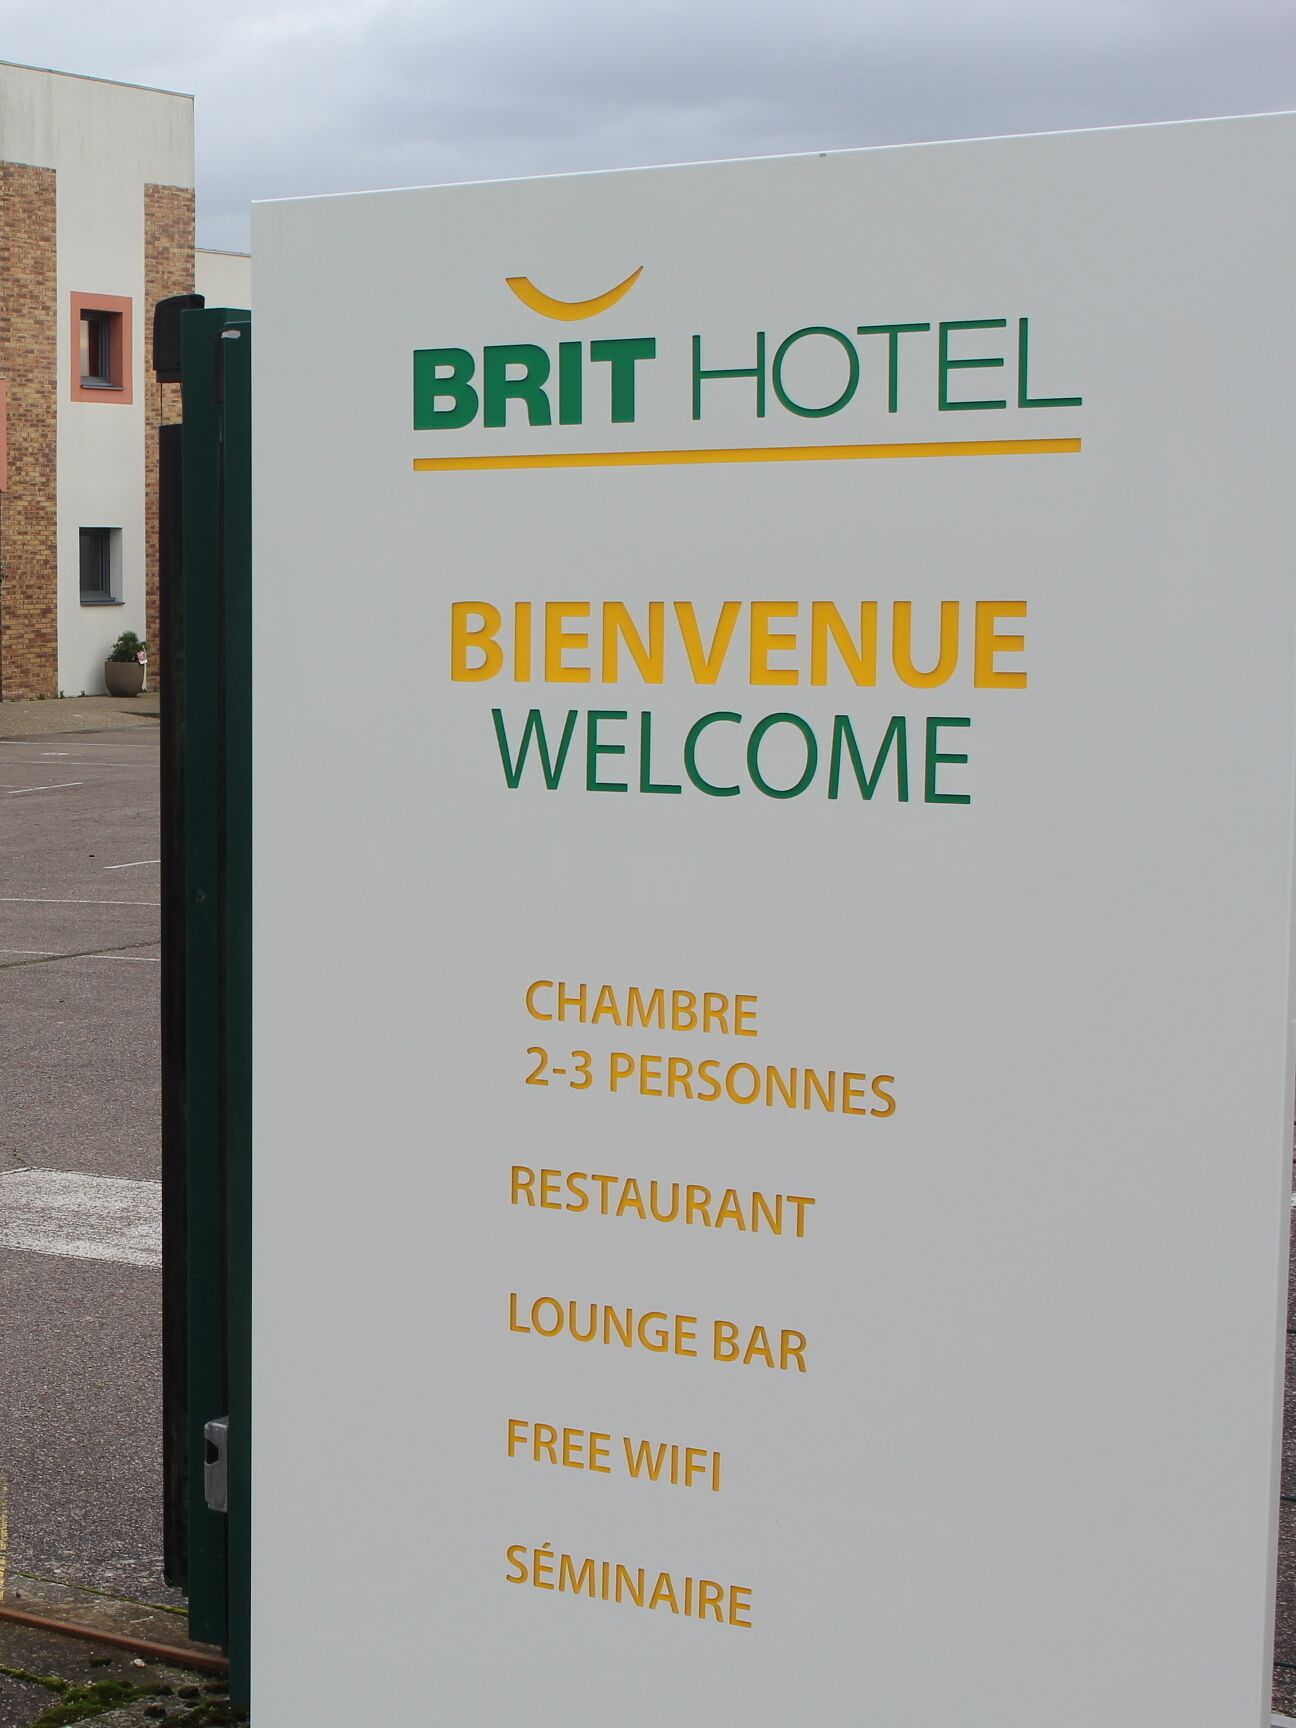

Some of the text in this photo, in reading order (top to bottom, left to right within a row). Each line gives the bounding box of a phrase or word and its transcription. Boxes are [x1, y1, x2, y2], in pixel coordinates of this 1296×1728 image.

[413, 317, 1083, 431] BRIT HOTEL
[450, 600, 1028, 690] BIENVENUE
[491, 708, 971, 805] WELCOME
[524, 979, 758, 1037] CHAMBRE
[524, 1046, 897, 1118] 2-3 PERSONNES
[510, 1165, 816, 1238] RESTAURANT
[509, 1292, 807, 1373] LOUNGE BAR
[507, 1418, 721, 1492] FREE WIFI
[505, 1542, 752, 1629] SÉMINAIRE
